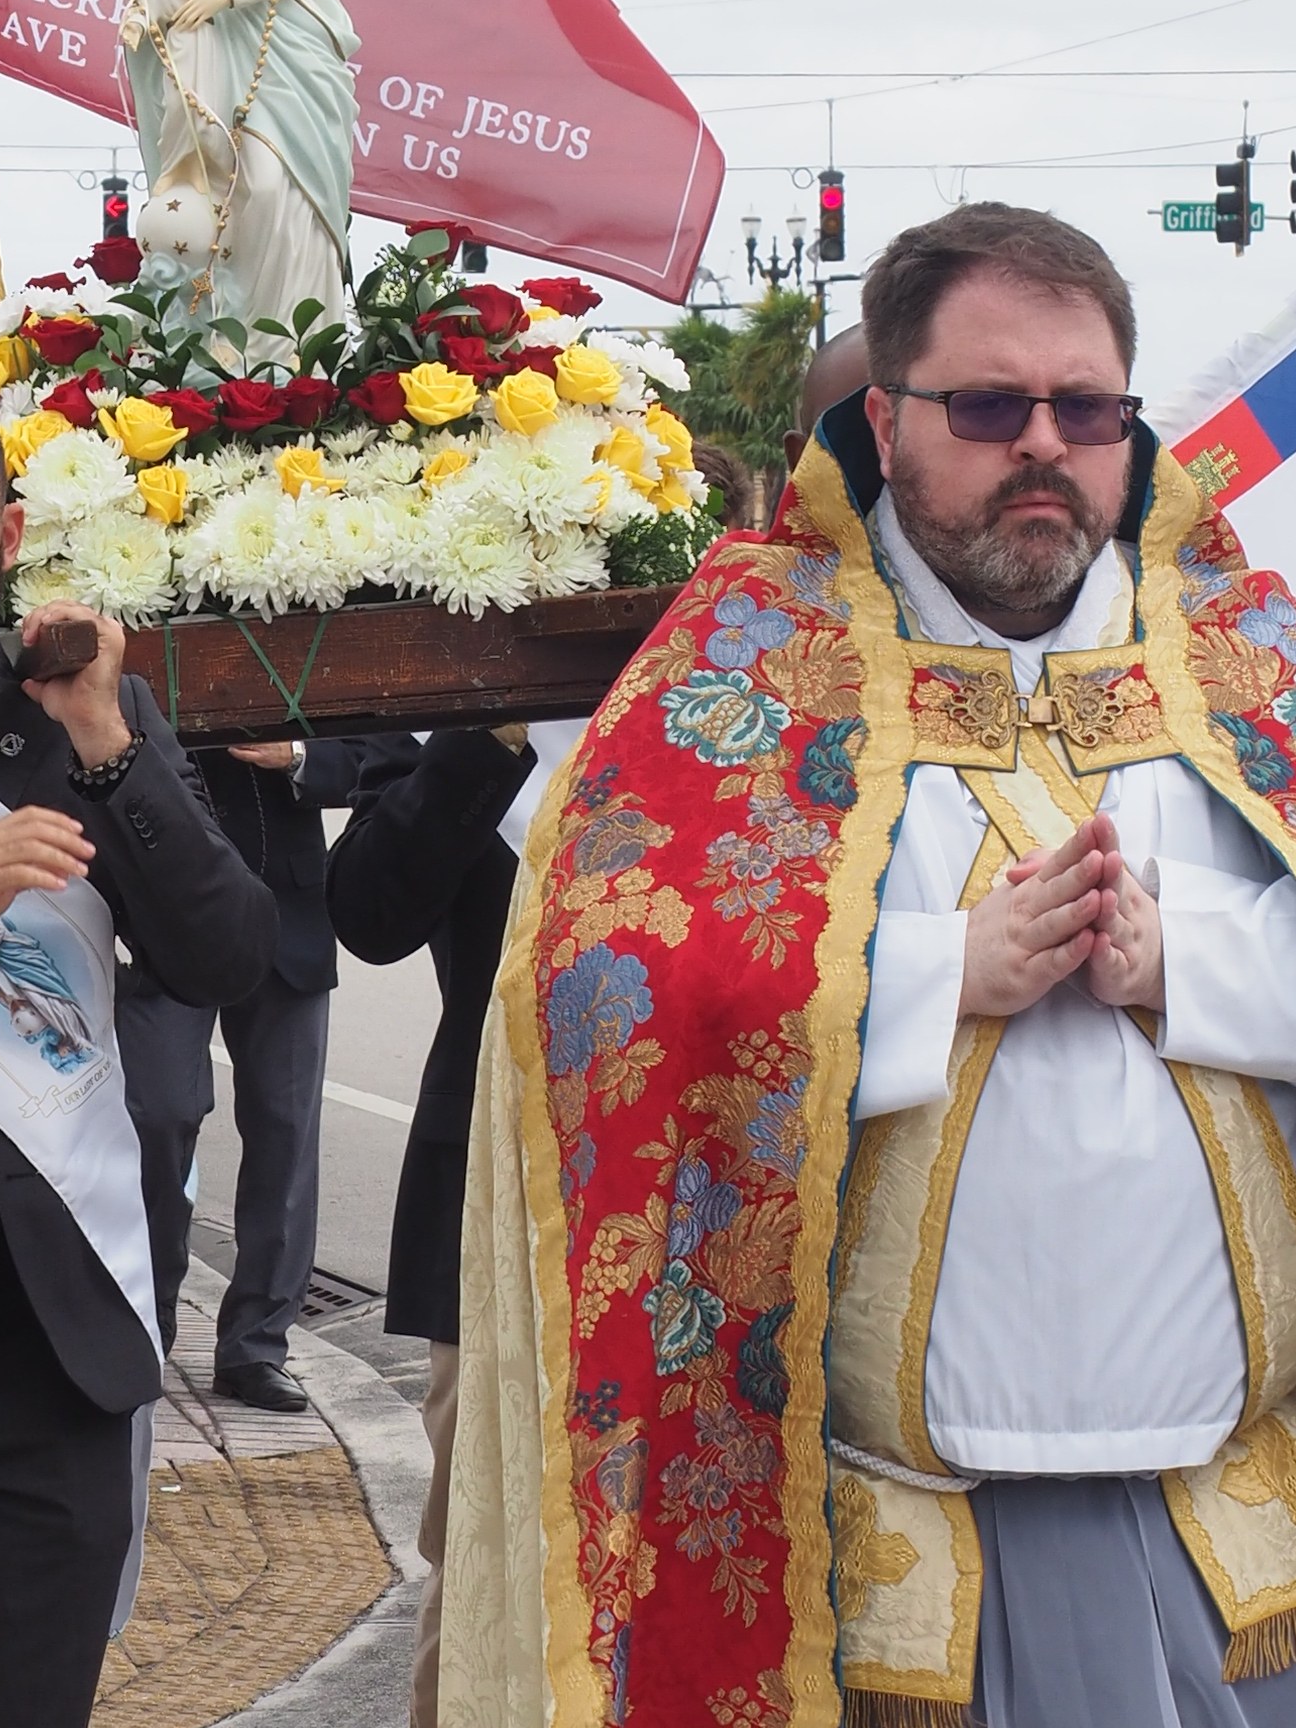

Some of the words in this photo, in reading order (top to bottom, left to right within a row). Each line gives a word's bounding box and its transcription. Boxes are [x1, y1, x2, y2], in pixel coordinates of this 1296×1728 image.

[379, 75, 444, 118] OF
[452, 96, 592, 160] JESUS
[403, 134, 462, 179] US
[1166, 205, 1228, 229] Griffi
